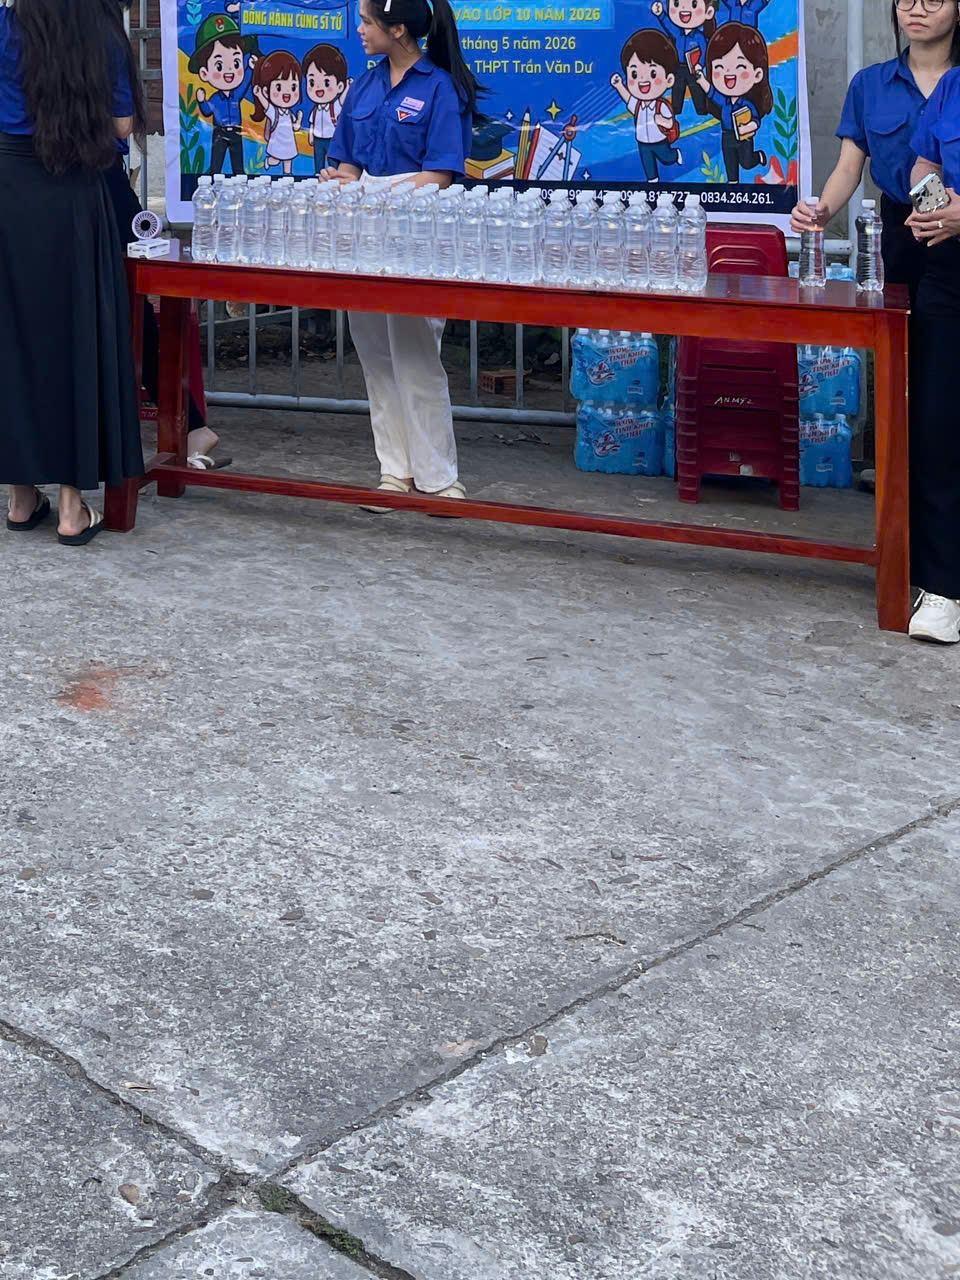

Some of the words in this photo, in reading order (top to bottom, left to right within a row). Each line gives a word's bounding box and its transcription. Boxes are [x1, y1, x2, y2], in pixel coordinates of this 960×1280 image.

[485, 6, 512, 21] LỚP
[517, 8, 531, 21] 10
[535, 5, 565, 21] NĂM
[569, 7, 601, 21] 2026
[461, 35, 499, 53] tháng
[502, 37, 510, 50] 5
[513, 36, 541, 50] năm
[545, 37, 576, 50] 2026
[474, 60, 509, 74] THPT
[512, 59, 541, 74] Trần
[545, 60, 570, 74] Văn
[574, 60, 594, 74] Dư
